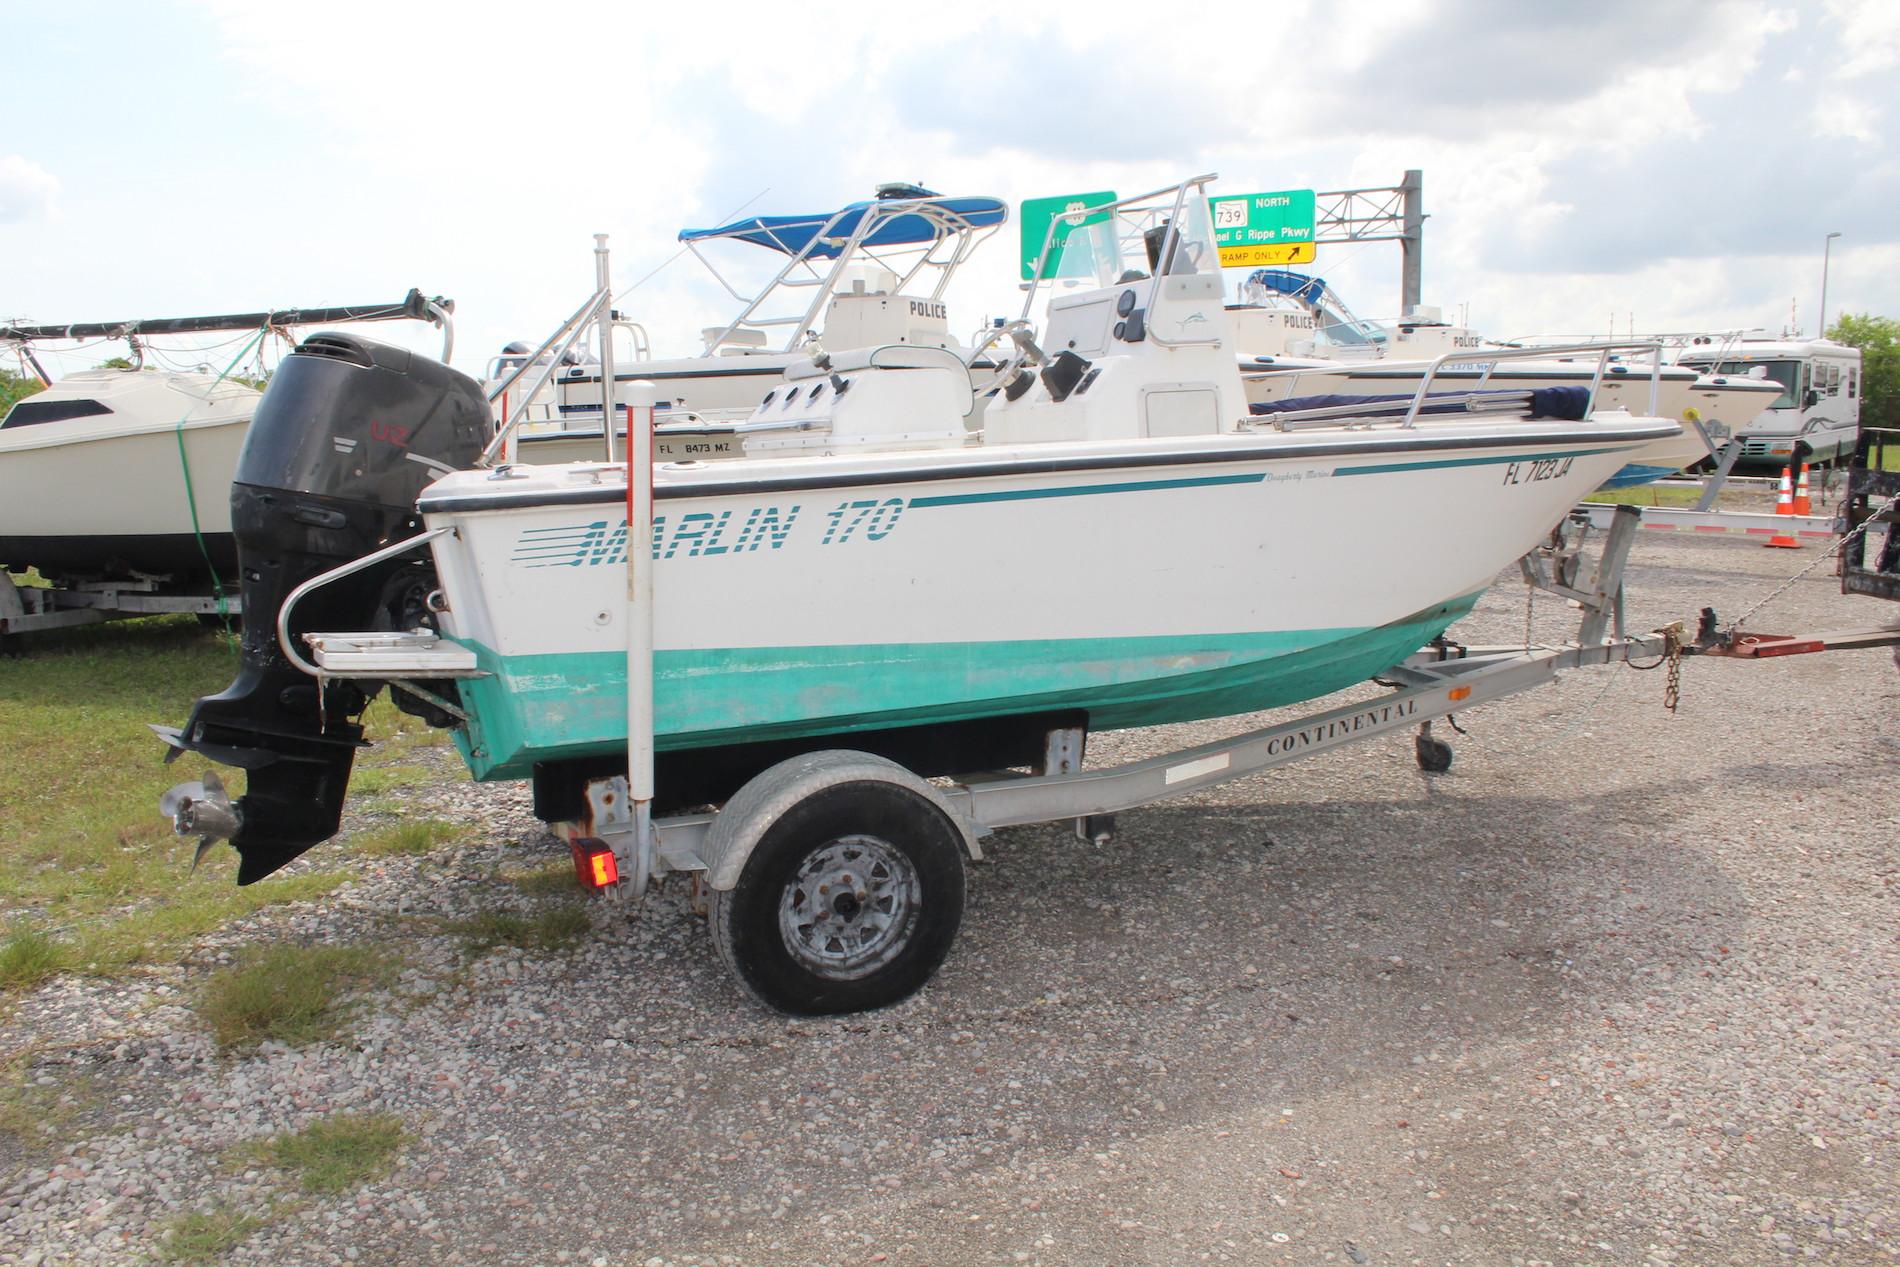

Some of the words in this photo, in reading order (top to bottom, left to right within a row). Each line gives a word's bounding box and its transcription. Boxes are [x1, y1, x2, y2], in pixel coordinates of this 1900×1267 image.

[1255, 197, 1290, 208] NORTH
[1216, 210, 1241, 224] 739
[1235, 230, 1243, 240] G
[1248, 229, 1276, 241] Rippe
[1281, 226, 1310, 240] Pkwy
[1221, 252, 1249, 262] RAMP
[1254, 250, 1281, 260] ONLY
[910, 300, 947, 319] POLICE
[1284, 314, 1313, 329] POLICE
[1453, 336, 1480, 348] POLICE
[659, 445, 673, 454] FL
[685, 443, 711, 453] 8473
[715, 442, 732, 452] MZ
[1503, 462, 1520, 486] FL
[1524, 458, 1560, 483] 7123
[821, 497, 904, 545] 170
[1266, 700, 1418, 756] CONTINENTAL
